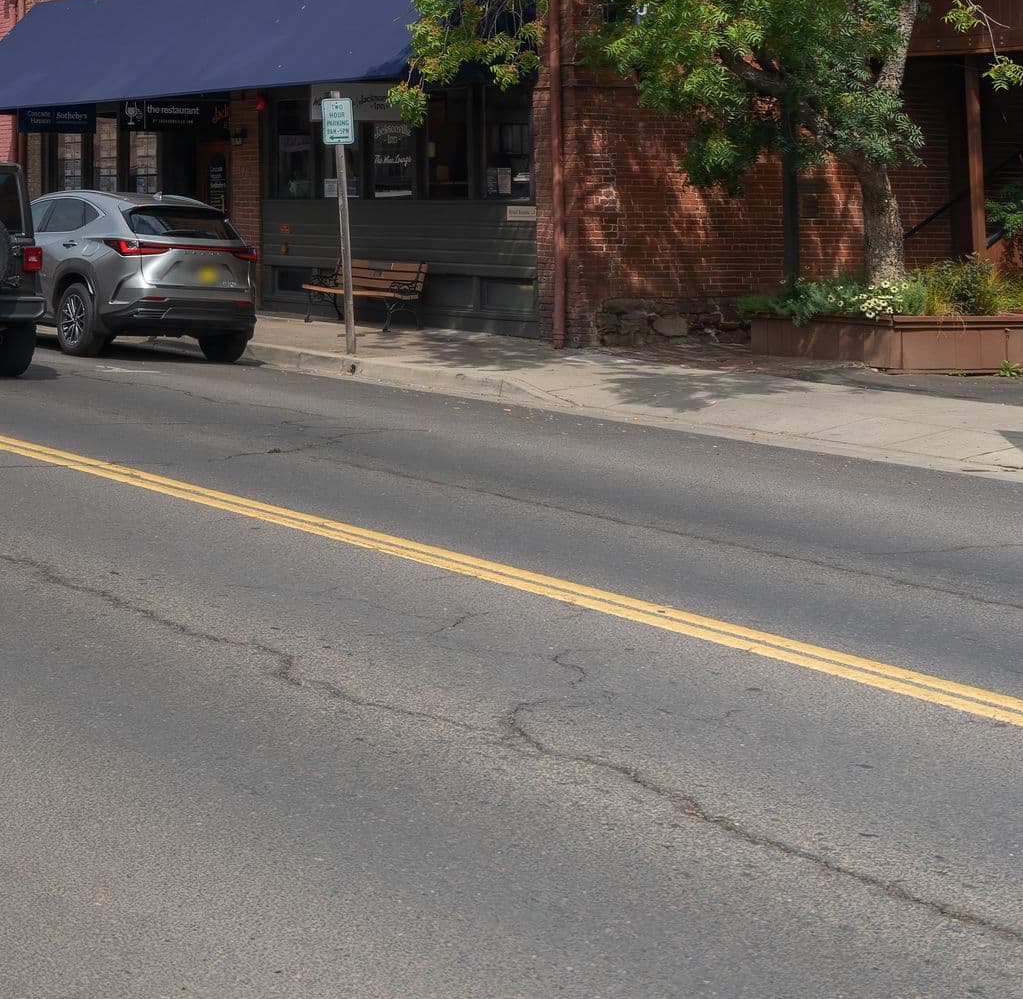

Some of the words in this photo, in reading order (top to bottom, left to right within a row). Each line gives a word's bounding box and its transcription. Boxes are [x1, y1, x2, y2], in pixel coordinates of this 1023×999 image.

[147, 104, 159, 114] the
[161, 105, 200, 115] restaurant
[387, 135, 398, 144] Inn
